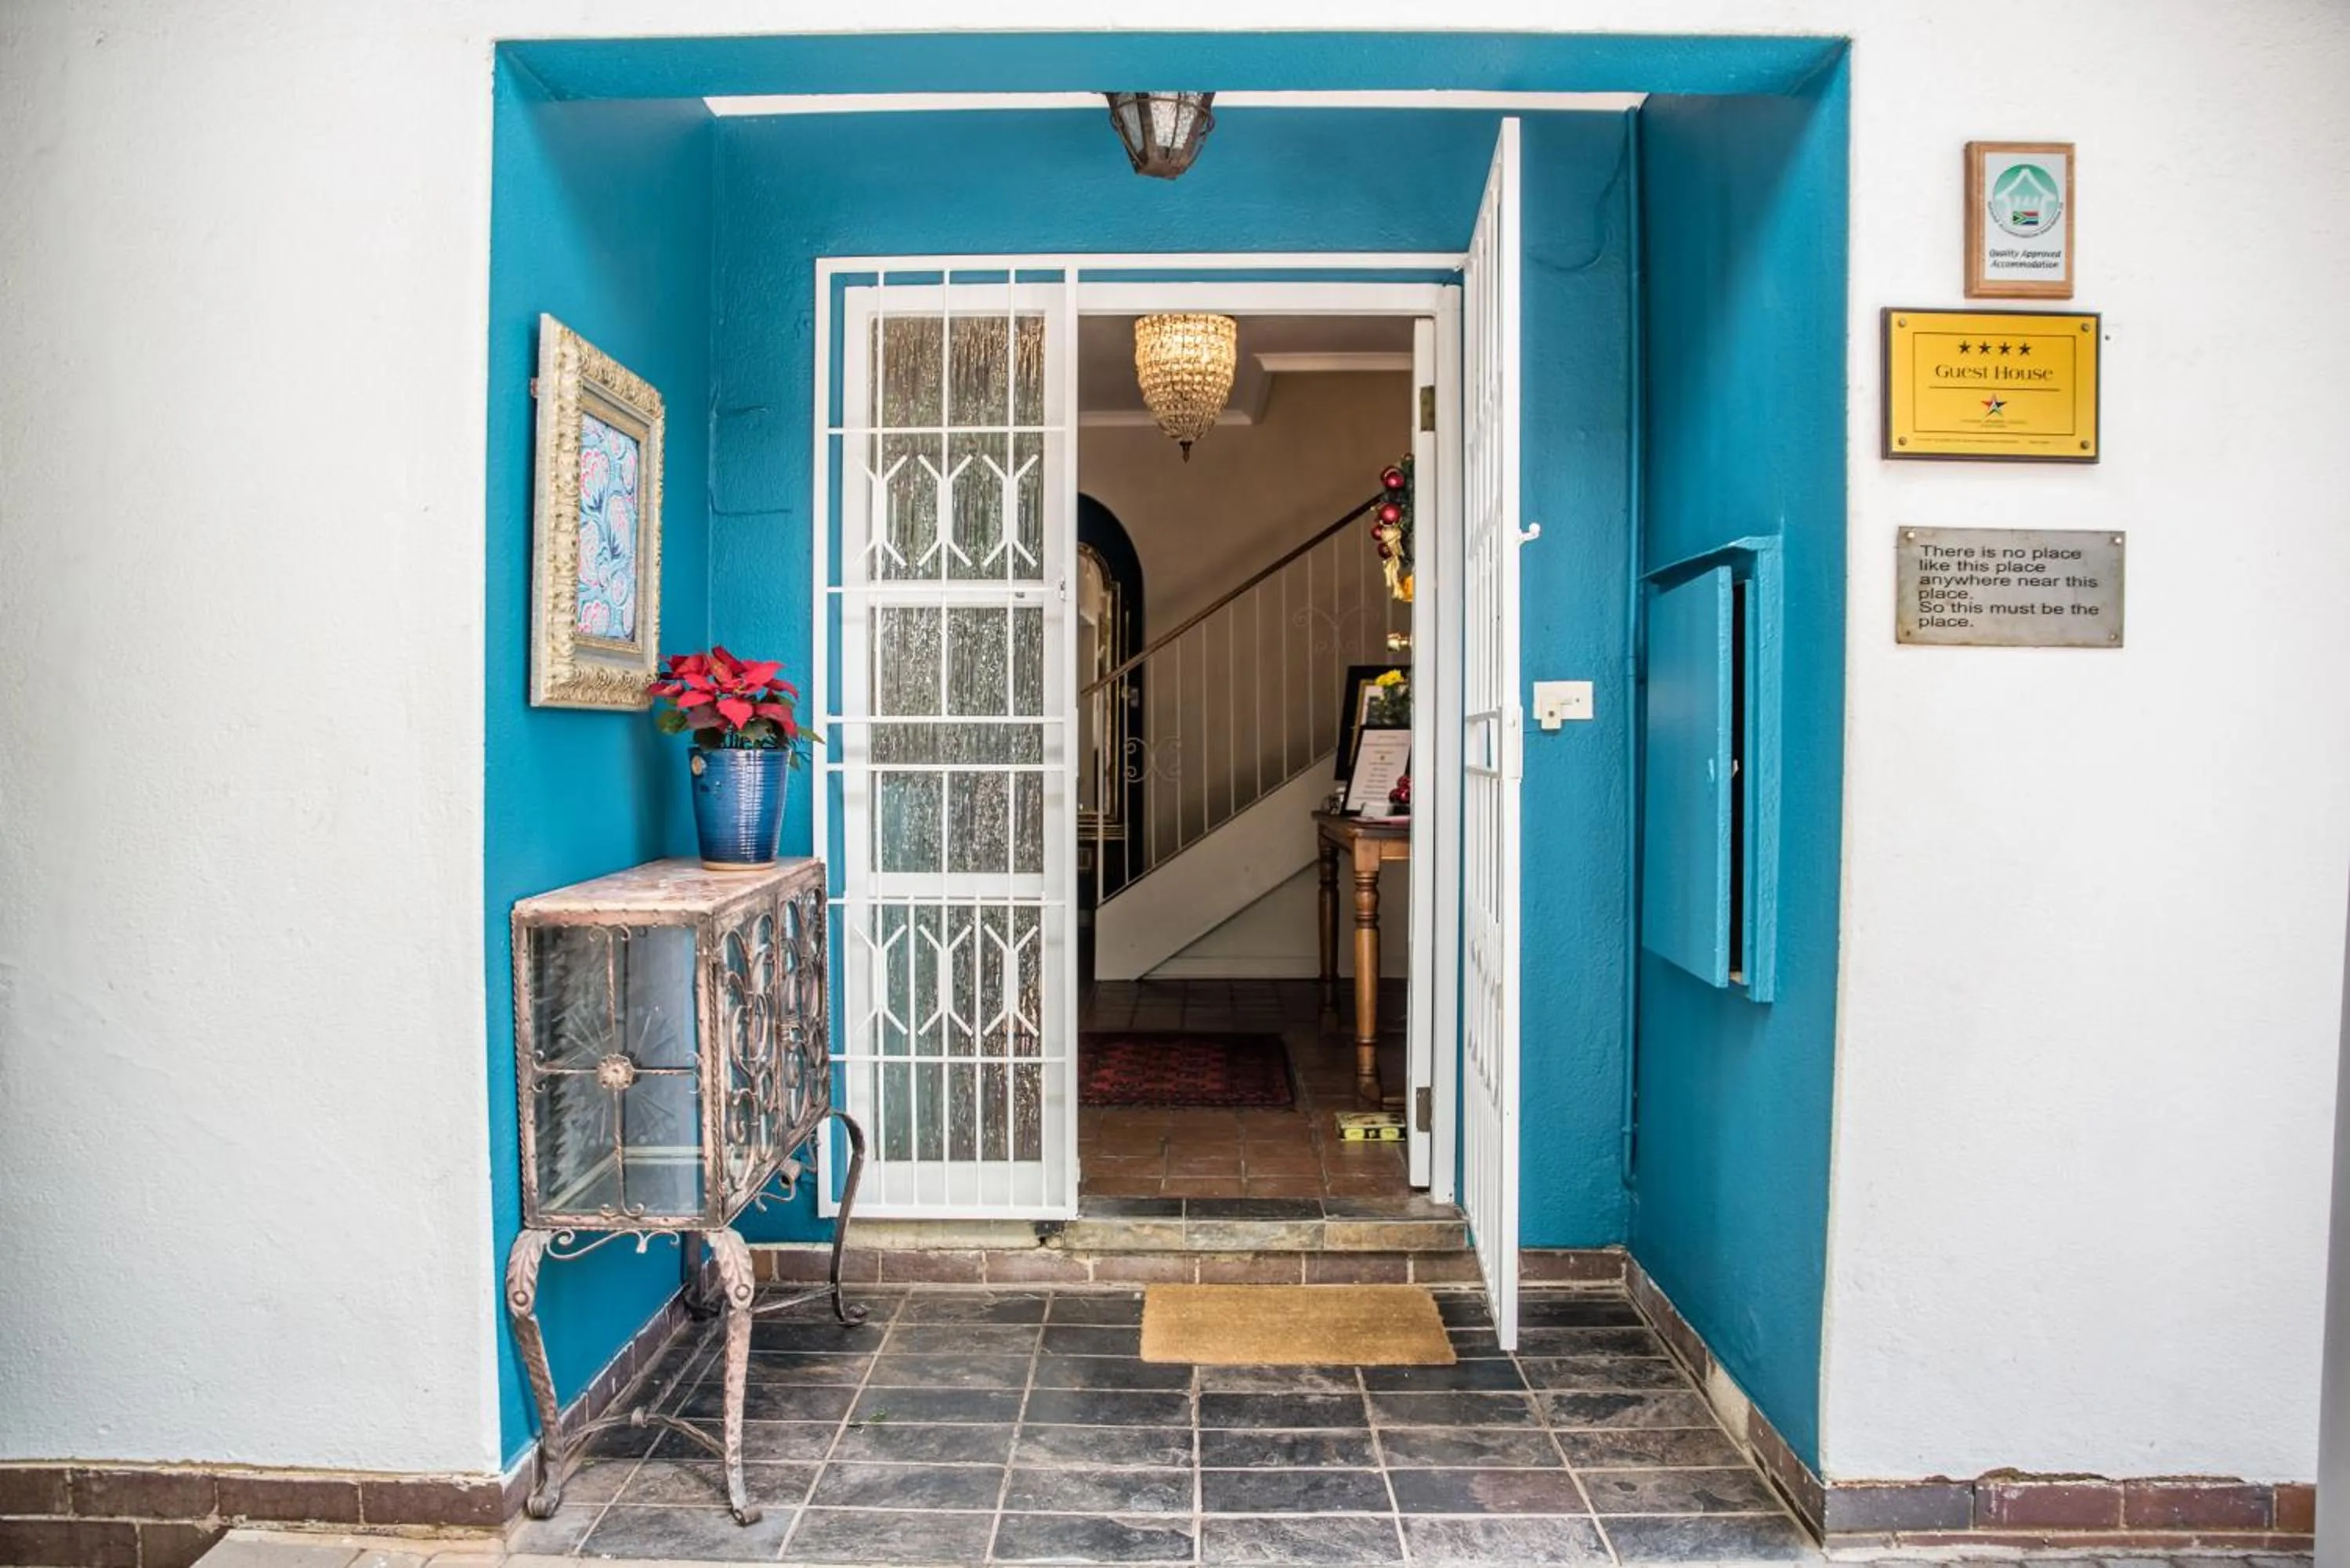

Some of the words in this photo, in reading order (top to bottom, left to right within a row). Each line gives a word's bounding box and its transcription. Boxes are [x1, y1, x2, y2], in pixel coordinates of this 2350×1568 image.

[1935, 364, 1988, 379] Guest
[1994, 366, 2053, 381] House
[1921, 545, 1975, 558] There
[1982, 547, 1997, 558] is
[2003, 548, 2026, 559] no
[2032, 547, 2081, 562] place
[1919, 561, 1950, 572] like
[1958, 561, 1989, 573] this
[1996, 561, 2046, 575] place
[1919, 574, 2011, 588] anywhere
[2017, 576, 2060, 587] near
[2066, 576, 2099, 588] this
[1918, 587, 1974, 602] place.
[1919, 602, 1945, 613] So
[1950, 602, 1983, 614] this
[1990, 603, 2036, 615] must
[2041, 603, 2063, 615] be
[2070, 603, 2099, 616] the
[1918, 616, 1974, 630] place.
